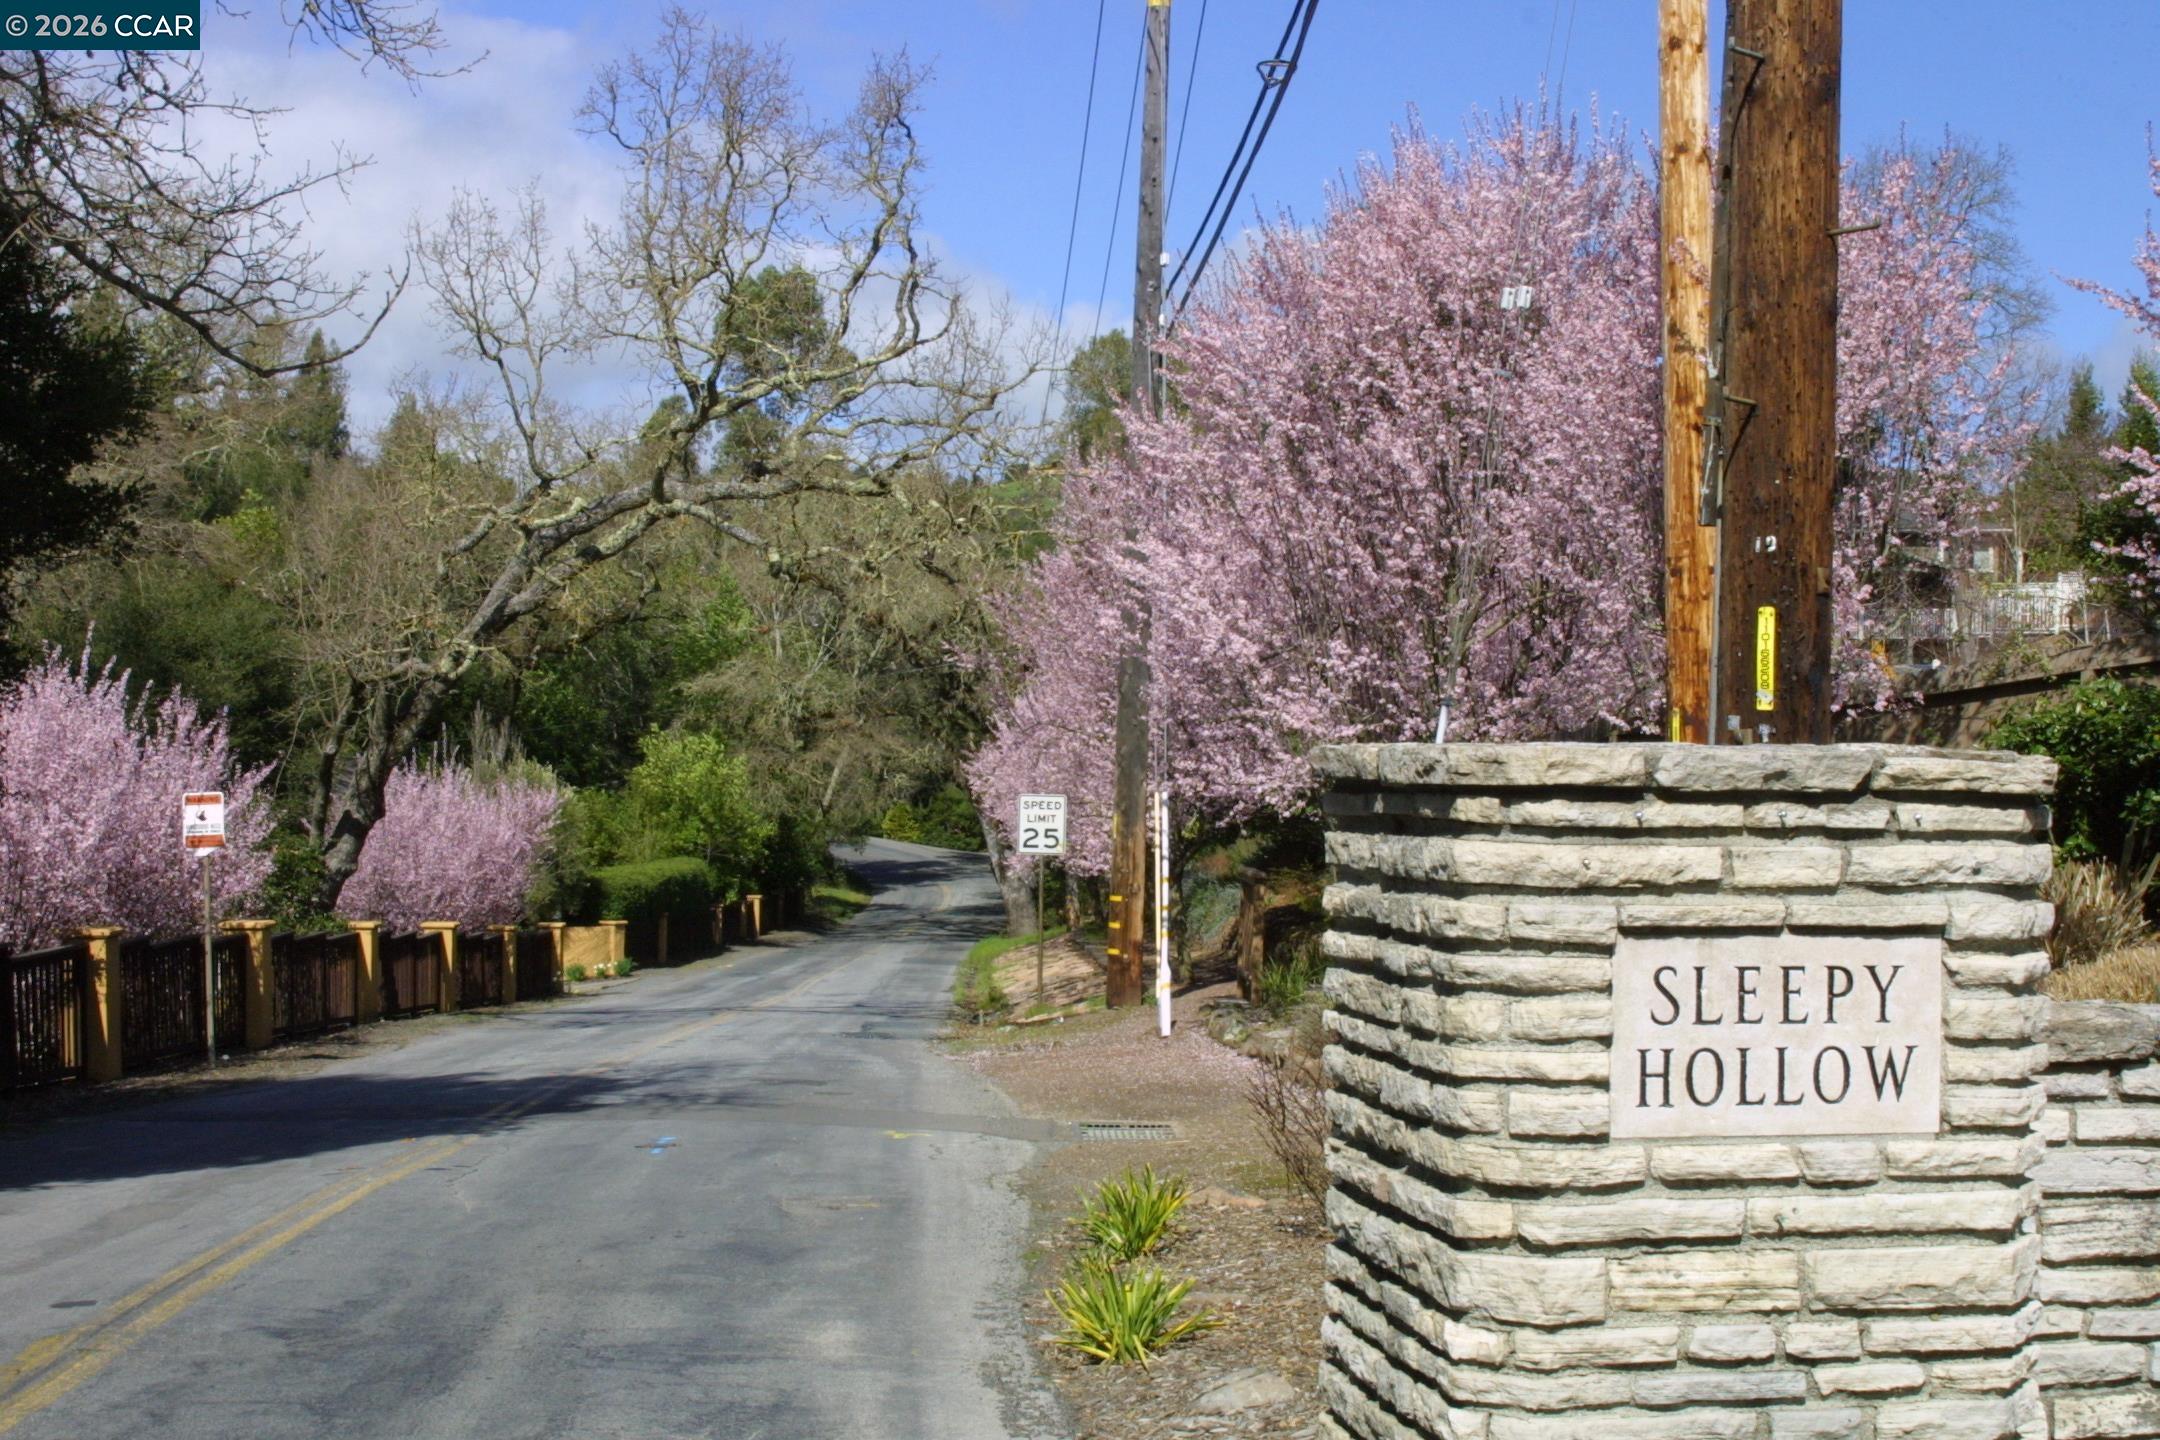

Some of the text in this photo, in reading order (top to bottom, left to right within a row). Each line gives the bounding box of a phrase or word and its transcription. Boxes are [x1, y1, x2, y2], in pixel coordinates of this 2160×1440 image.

[1023, 800, 1062, 810] SPEED
[1027, 814, 1056, 823] LIMIT
[1023, 828, 1060, 849] 25
[1650, 964, 1905, 1026] SLEEPY
[1635, 1044, 1919, 1108] HOLLOW
